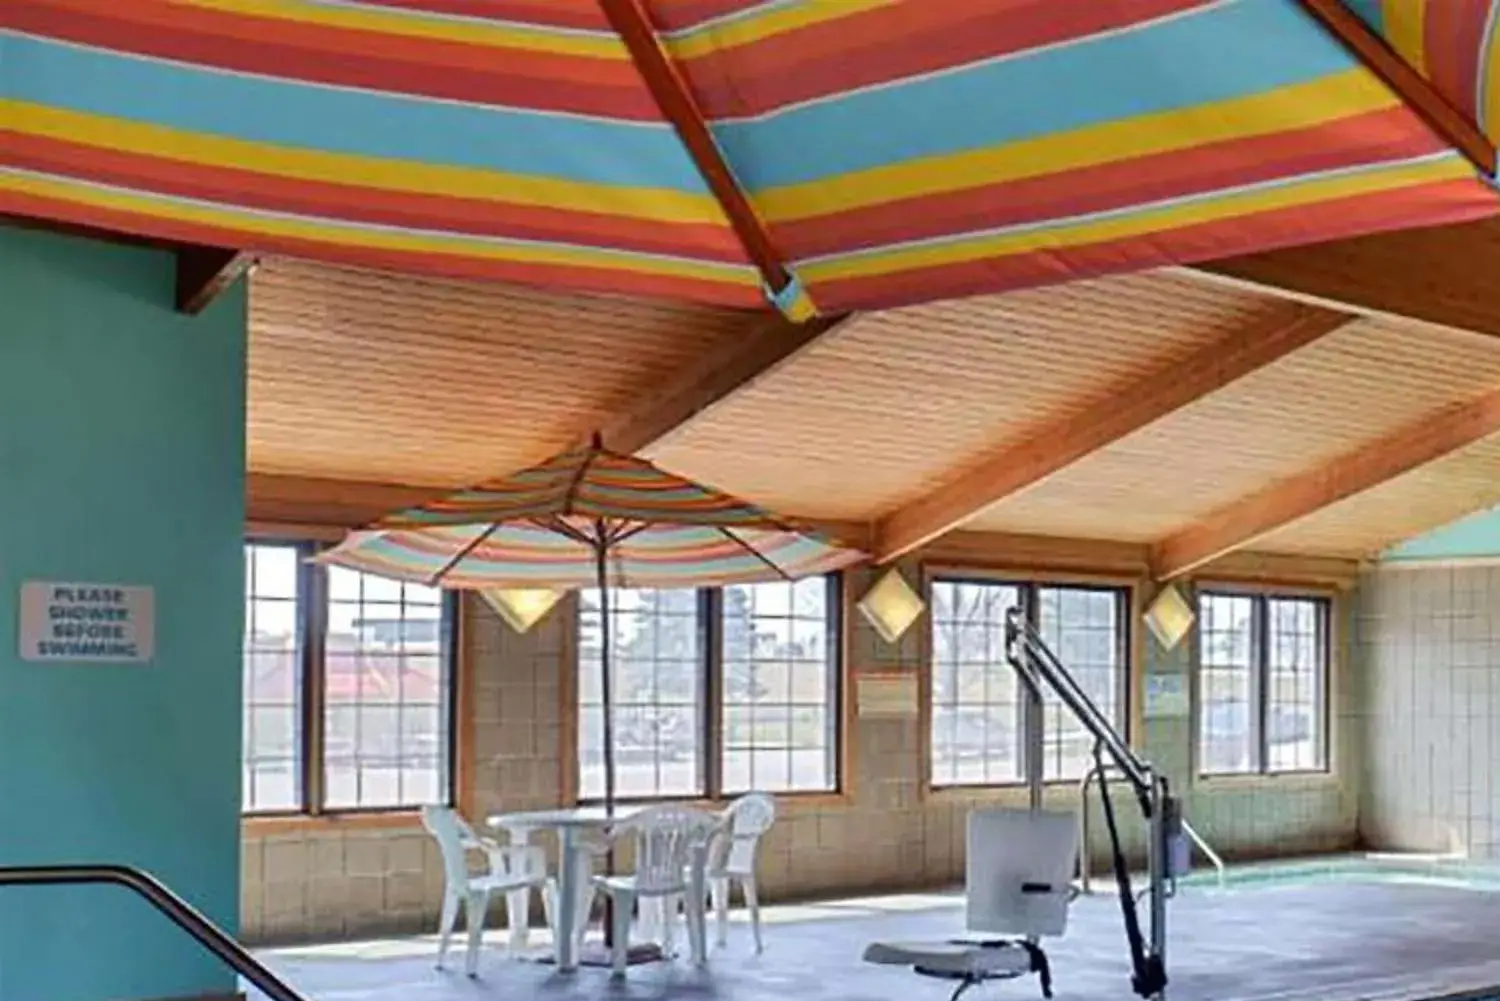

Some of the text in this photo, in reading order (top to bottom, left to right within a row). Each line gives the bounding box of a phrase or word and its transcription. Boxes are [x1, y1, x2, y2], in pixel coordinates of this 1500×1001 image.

[54, 587, 125, 602] PLEASE
[49, 606, 129, 620] SHOWER
[53, 625, 124, 639] BEFORE
[37, 641, 138, 657] SWIMMING
